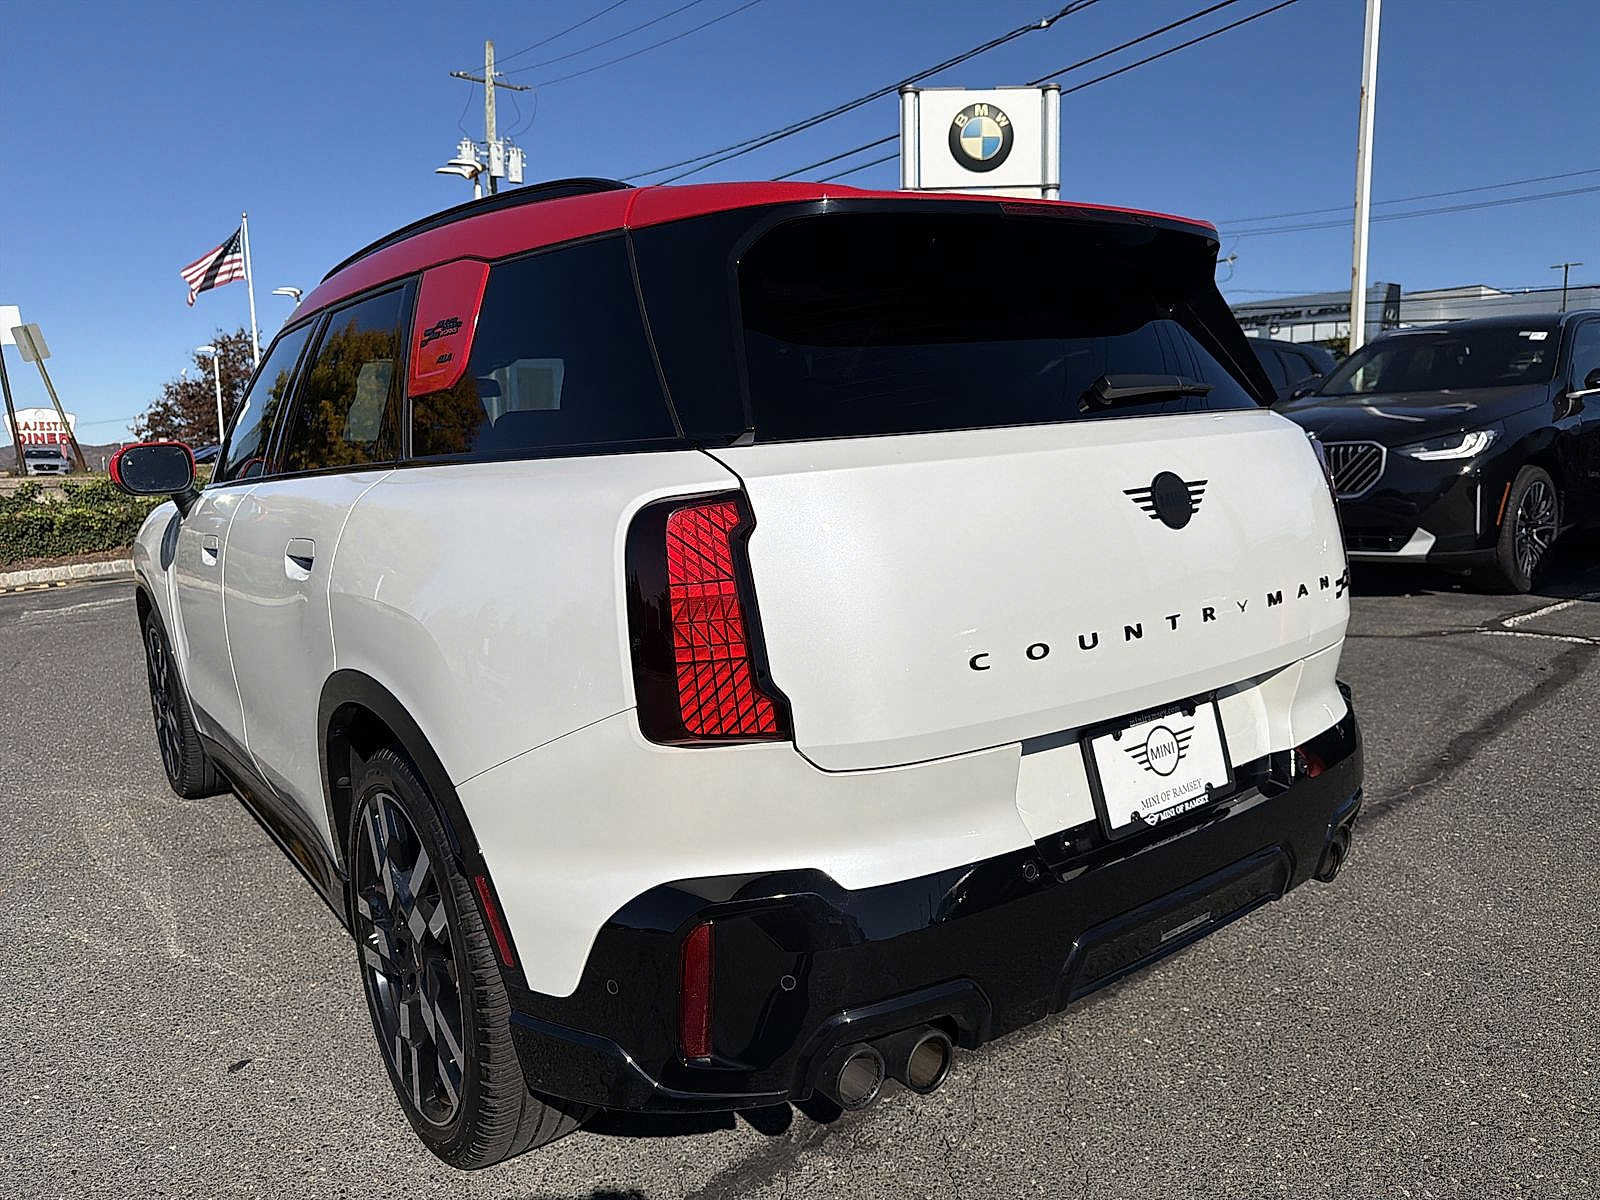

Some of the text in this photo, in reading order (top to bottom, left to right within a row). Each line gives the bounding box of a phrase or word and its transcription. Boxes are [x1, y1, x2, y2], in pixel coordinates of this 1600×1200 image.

[954, 104, 1009, 128] BMW
[16, 421, 69, 431] AJESTI
[19, 432, 70, 445] DINER
[968, 575, 1330, 672] COUNTRYMAN
[1150, 741, 1176, 761] MINI
[1140, 778, 1203, 811] MINI OF RAMSEY
[1160, 794, 1209, 821] MINI OF RAMSEY
